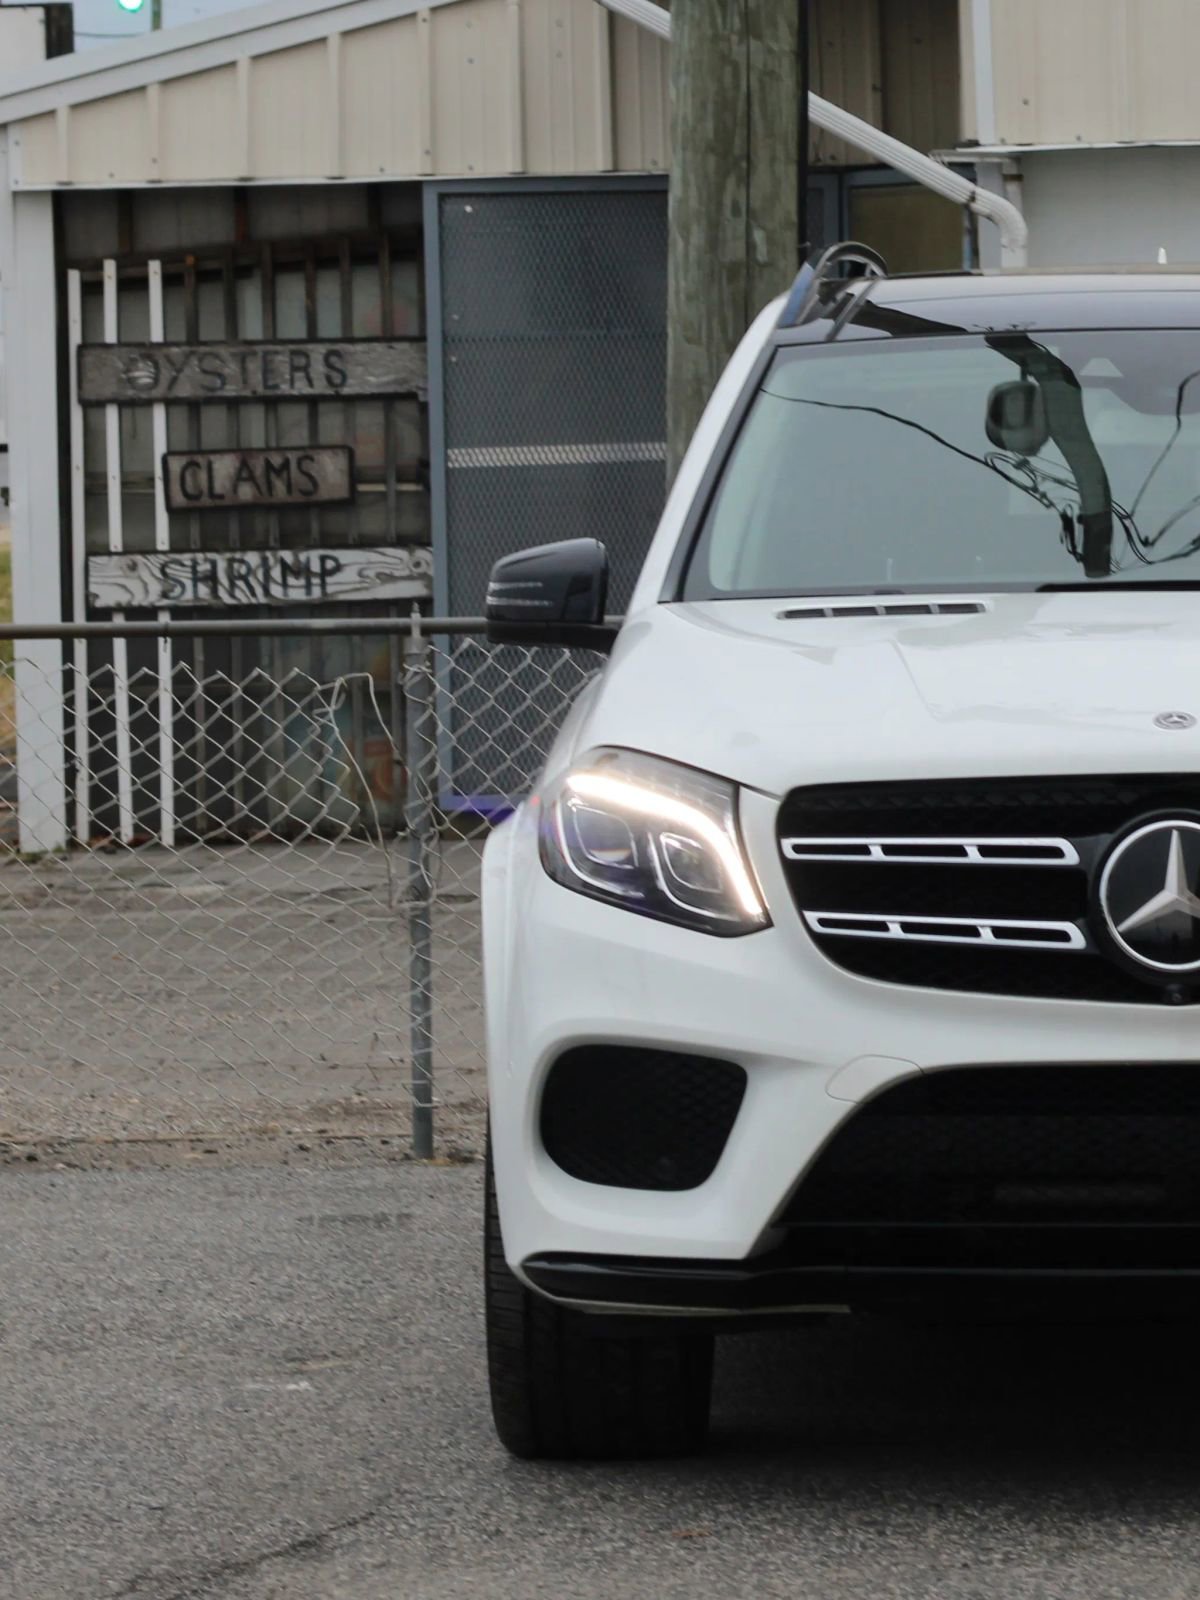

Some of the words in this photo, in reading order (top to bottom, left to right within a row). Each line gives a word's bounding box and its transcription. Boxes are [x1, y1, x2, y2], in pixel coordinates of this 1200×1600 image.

[123, 350, 350, 391] OYSTERS
[179, 454, 320, 500] CLAMS
[160, 554, 343, 600] SHRIMP
